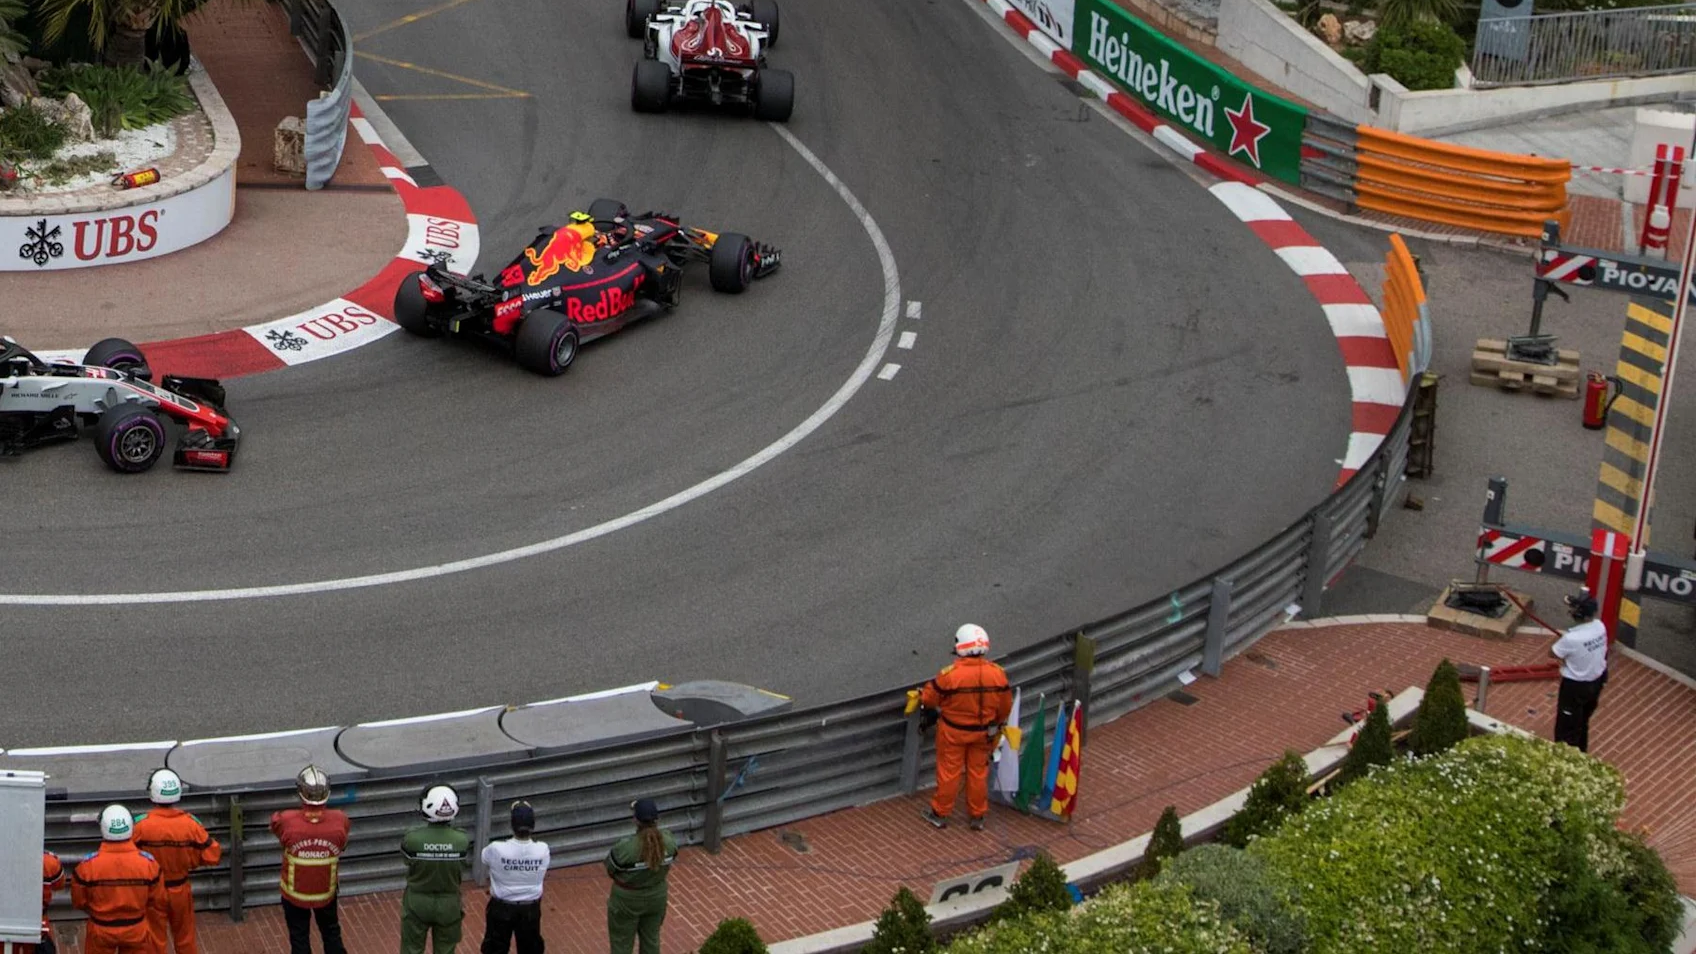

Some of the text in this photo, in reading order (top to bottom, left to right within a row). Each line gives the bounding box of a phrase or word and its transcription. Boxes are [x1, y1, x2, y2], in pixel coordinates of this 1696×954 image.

[426, 217, 460, 249] UBS
[1603, 268, 1696, 298] PIOVA
[296, 306, 377, 341] UBS
[1554, 554, 1692, 595] PINO
[298, 850, 330, 859] MONACO
[424, 843, 453, 851] DOCTOR
